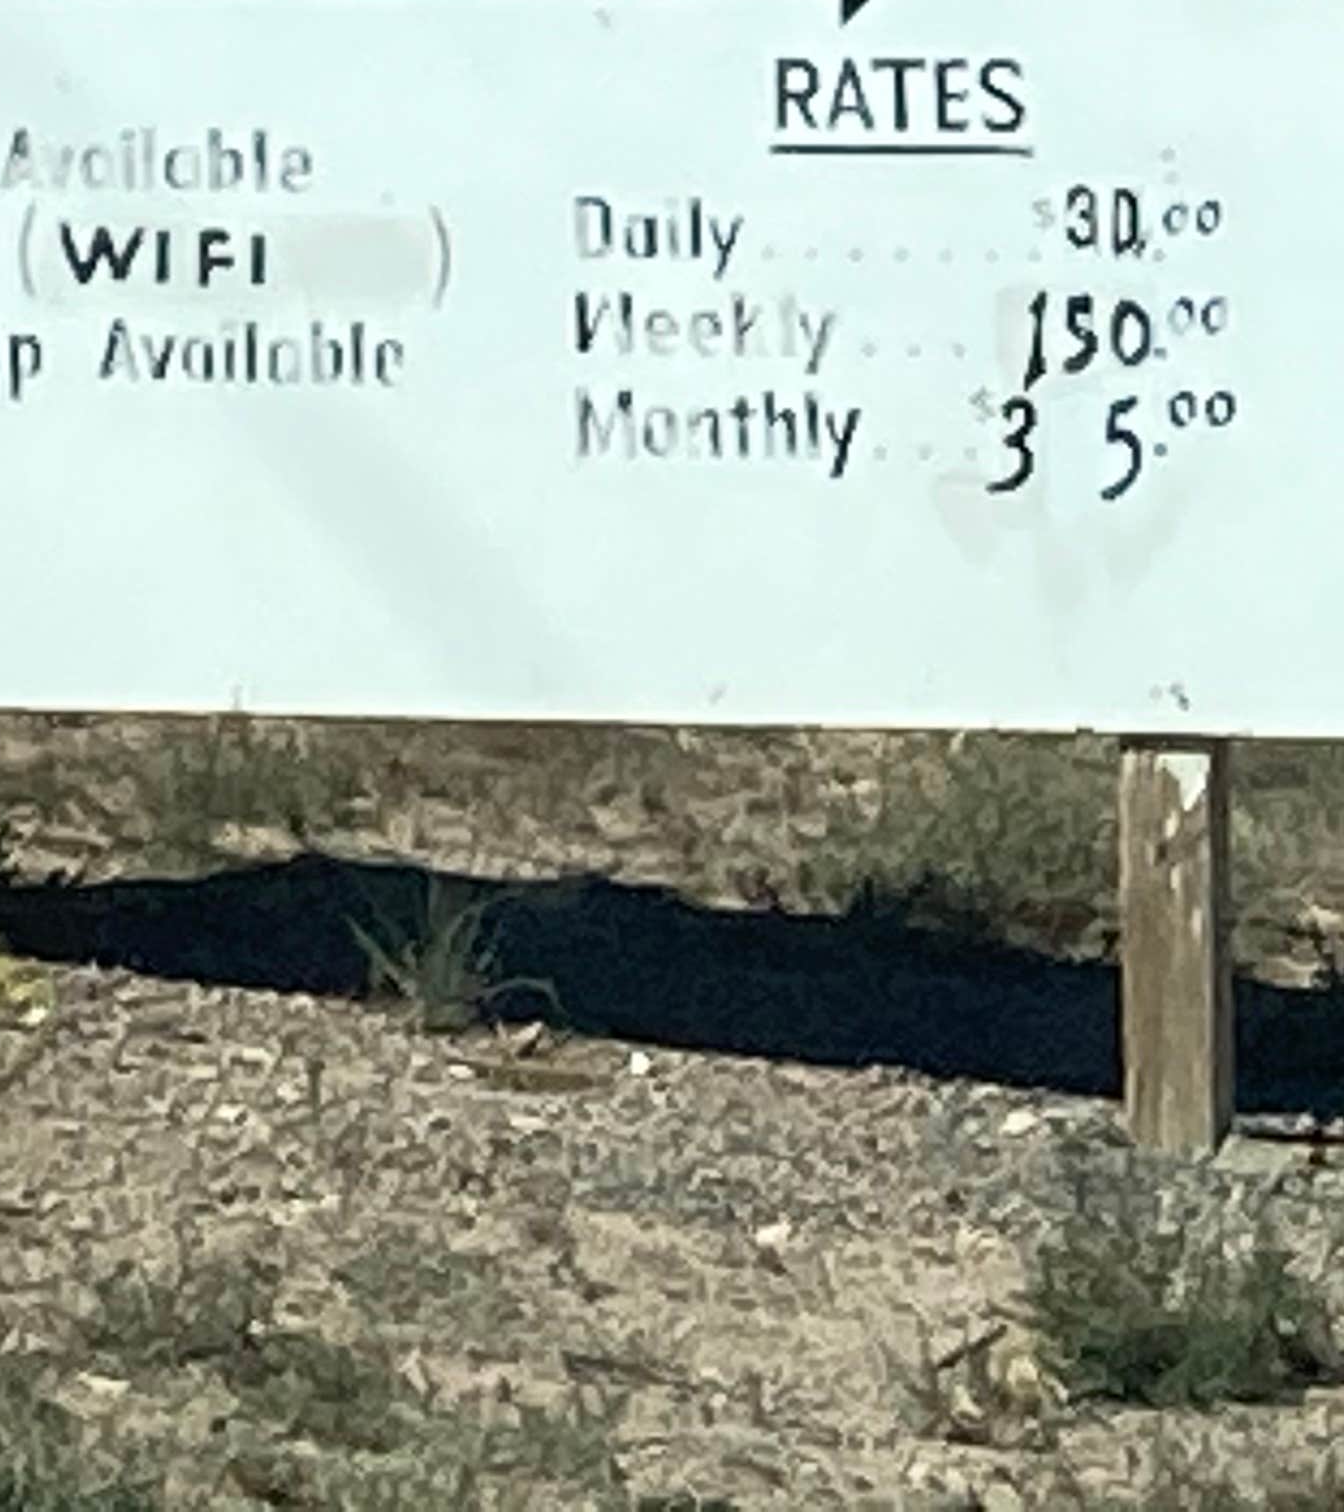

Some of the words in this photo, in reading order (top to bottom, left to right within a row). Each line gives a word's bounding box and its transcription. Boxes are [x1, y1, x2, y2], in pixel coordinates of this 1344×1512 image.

[773, 56, 1028, 133] RATES
[572, 194, 744, 280] Daily
[96, 316, 406, 388] Available
[572, 289, 839, 376] Weekly
[573, 388, 862, 480] Monthly
